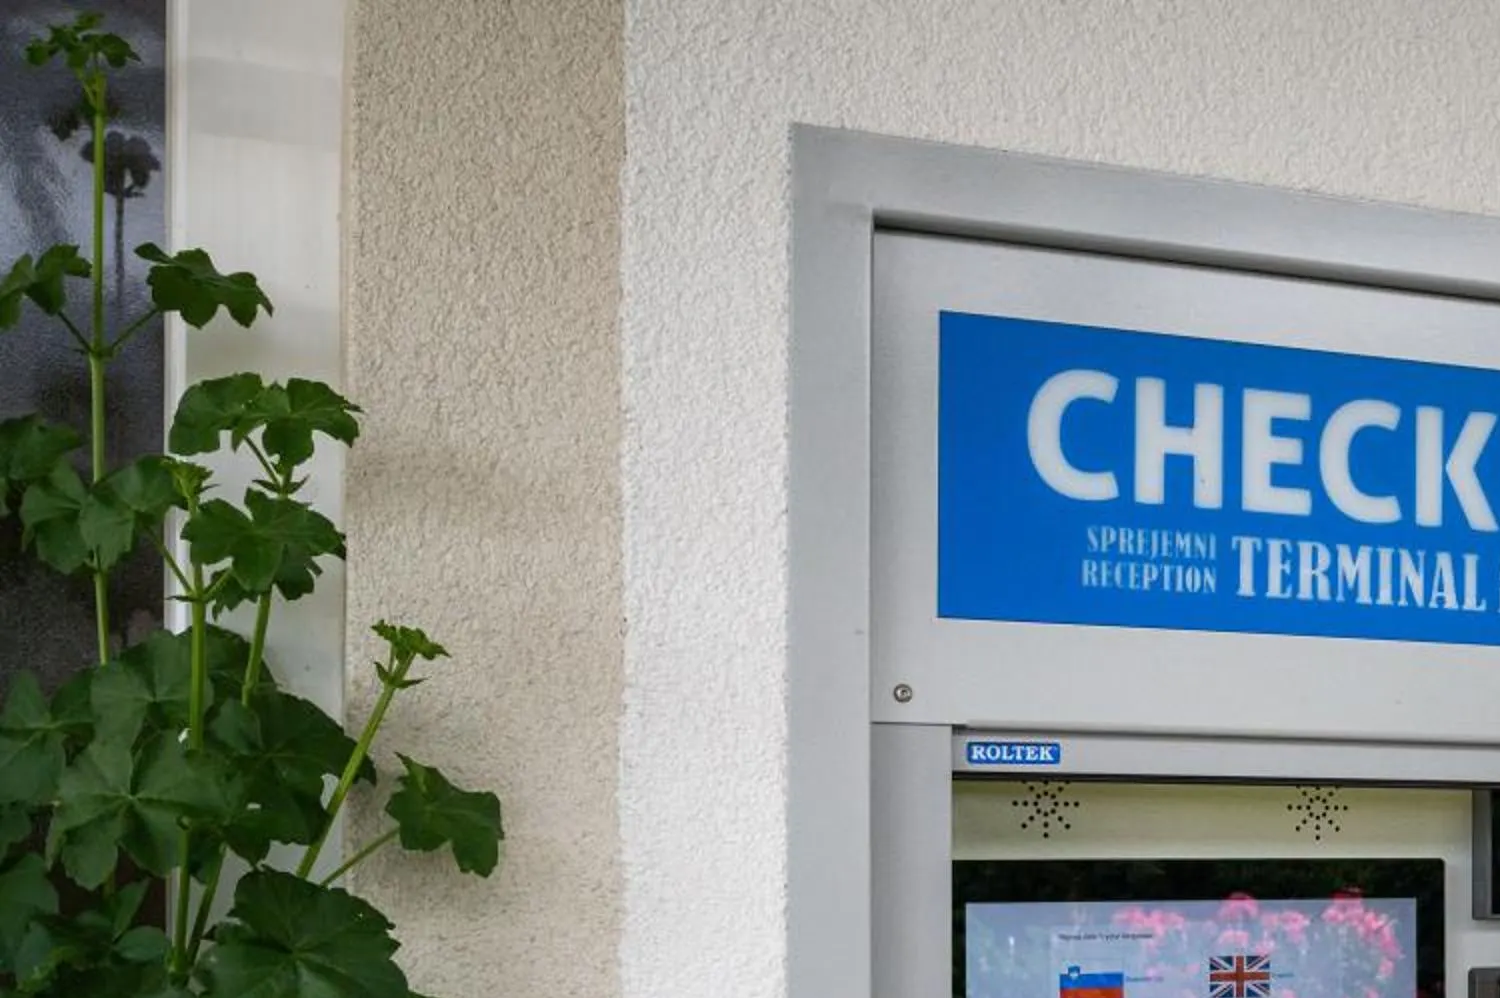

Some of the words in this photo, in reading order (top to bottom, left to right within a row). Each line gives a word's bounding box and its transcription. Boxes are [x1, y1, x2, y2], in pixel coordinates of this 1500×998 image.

[1027, 369, 1499, 532] CHECK
[1086, 525, 1217, 561] SPREJEMNI
[1082, 560, 1217, 593] RECEPTION
[1231, 535, 1487, 612] TERMINAL
[971, 744, 1055, 761] ROLTEK
